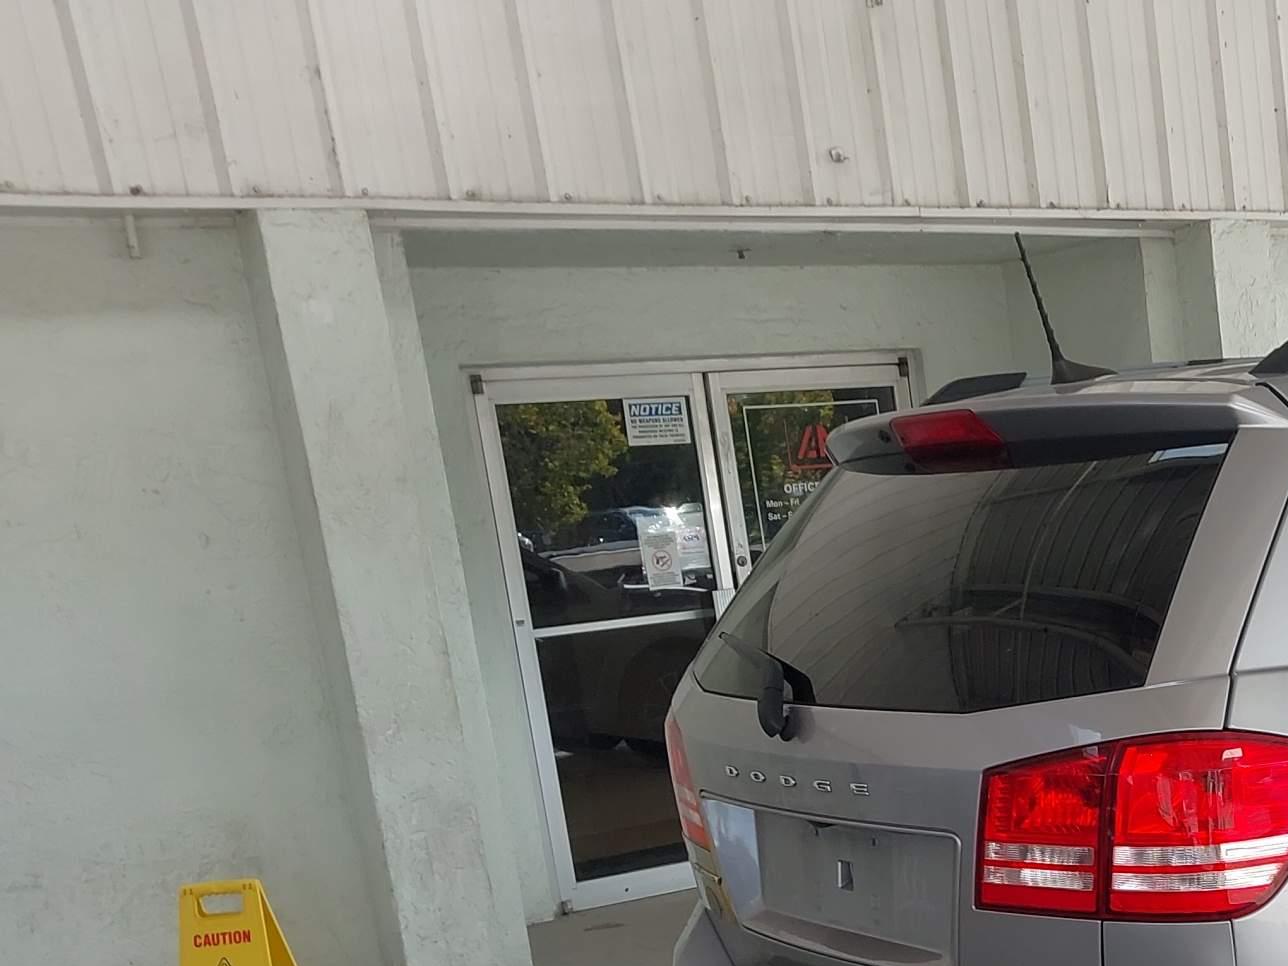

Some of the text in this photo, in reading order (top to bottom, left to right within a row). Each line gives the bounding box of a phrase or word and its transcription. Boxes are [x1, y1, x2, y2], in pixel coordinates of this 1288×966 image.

[631, 403, 681, 416] NOTICE
[766, 499, 783, 508] Mon
[767, 512, 781, 521] Sat
[725, 765, 869, 796] DODGE
[193, 930, 251, 948] CAUTION
